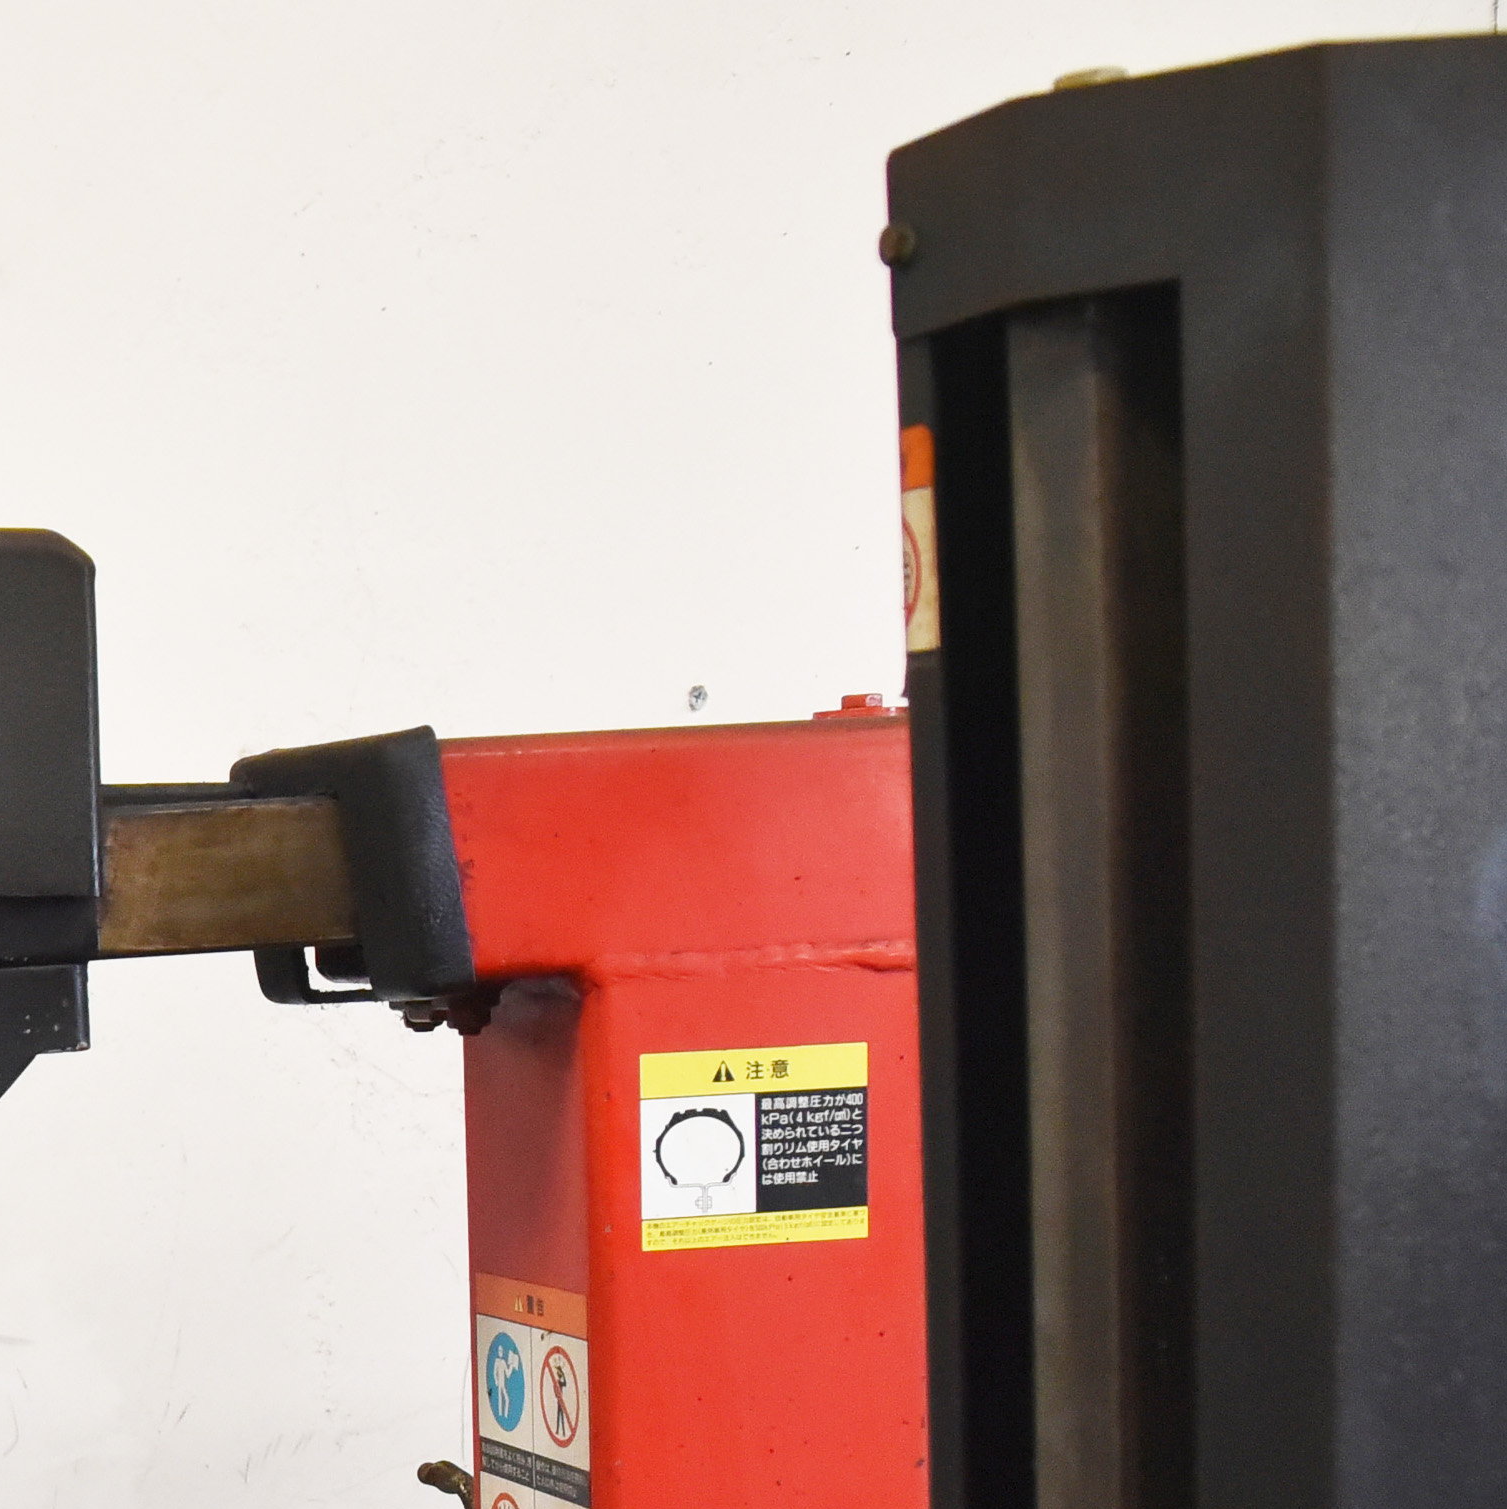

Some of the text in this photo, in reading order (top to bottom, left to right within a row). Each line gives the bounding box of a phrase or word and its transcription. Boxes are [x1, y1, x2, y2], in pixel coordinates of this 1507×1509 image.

[746, 1059, 789, 1080] 注意
[762, 1170, 818, 1185] は使用禁止
